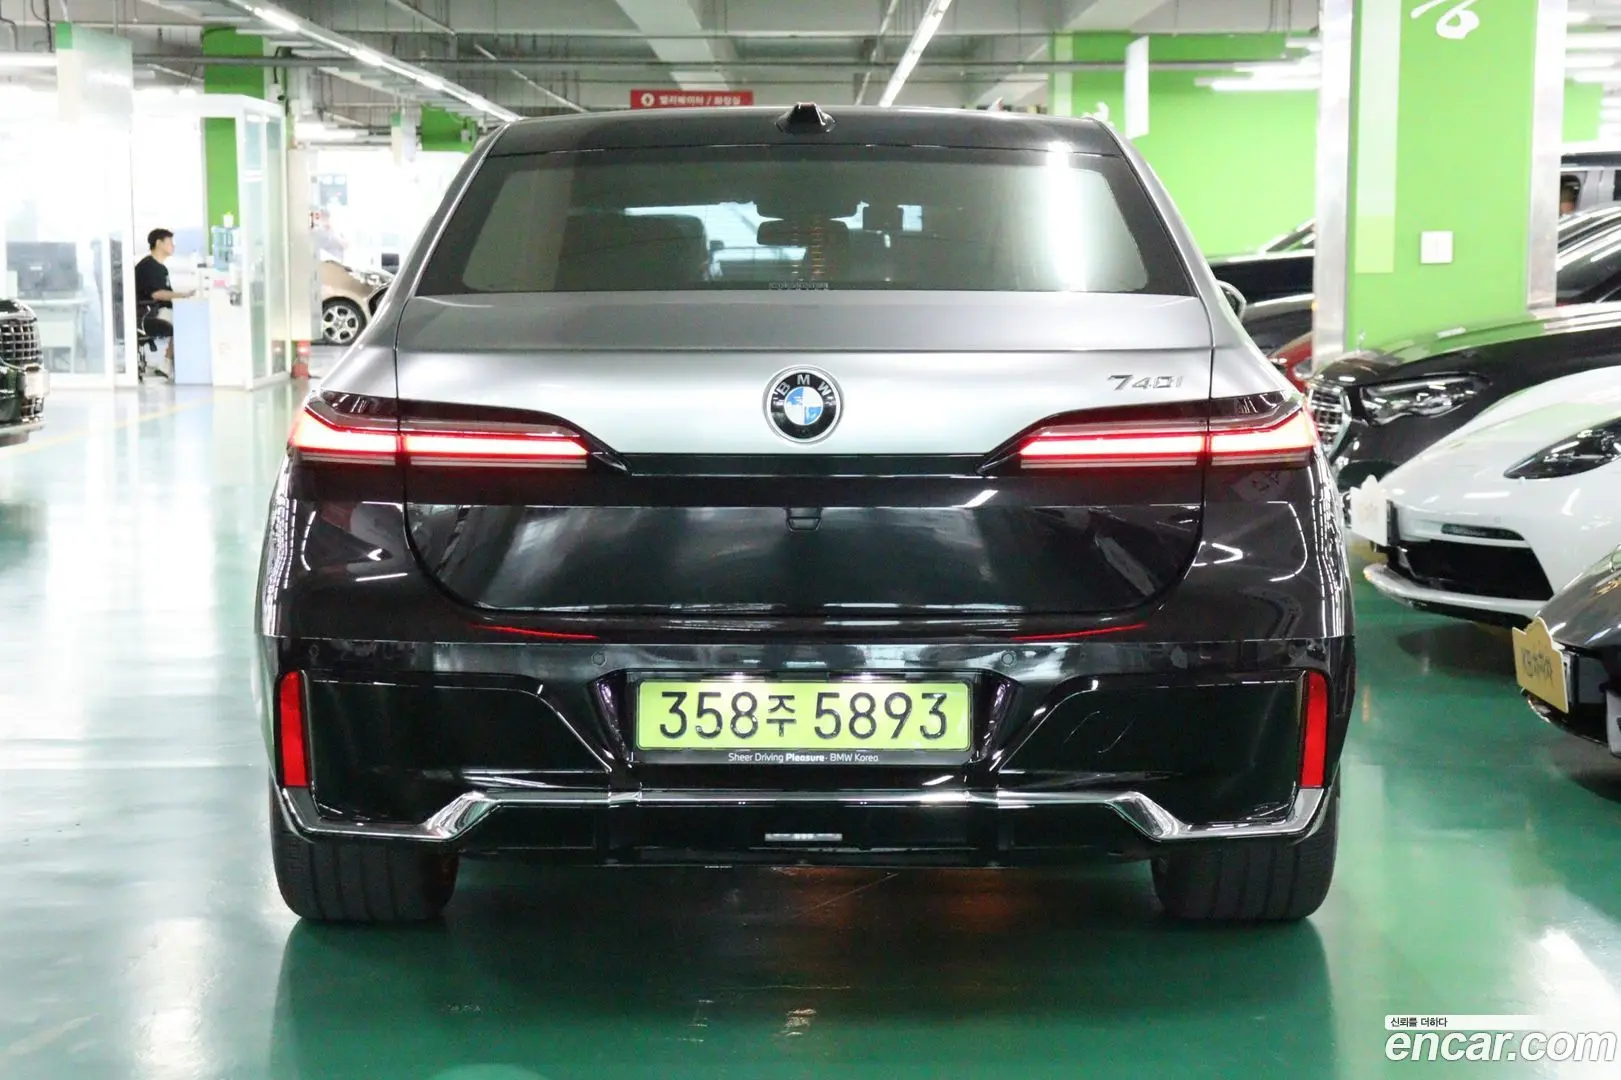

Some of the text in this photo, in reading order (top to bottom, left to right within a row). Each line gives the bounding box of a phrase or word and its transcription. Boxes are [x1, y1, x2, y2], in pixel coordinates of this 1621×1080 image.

[777, 373, 832, 397] BMW
[659, 691, 948, 740] 358주 5893
[728, 752, 753, 762] Sheer
[754, 752, 784, 764] Driving
[829, 752, 853, 762] BMW
[854, 752, 879, 762] Korea
